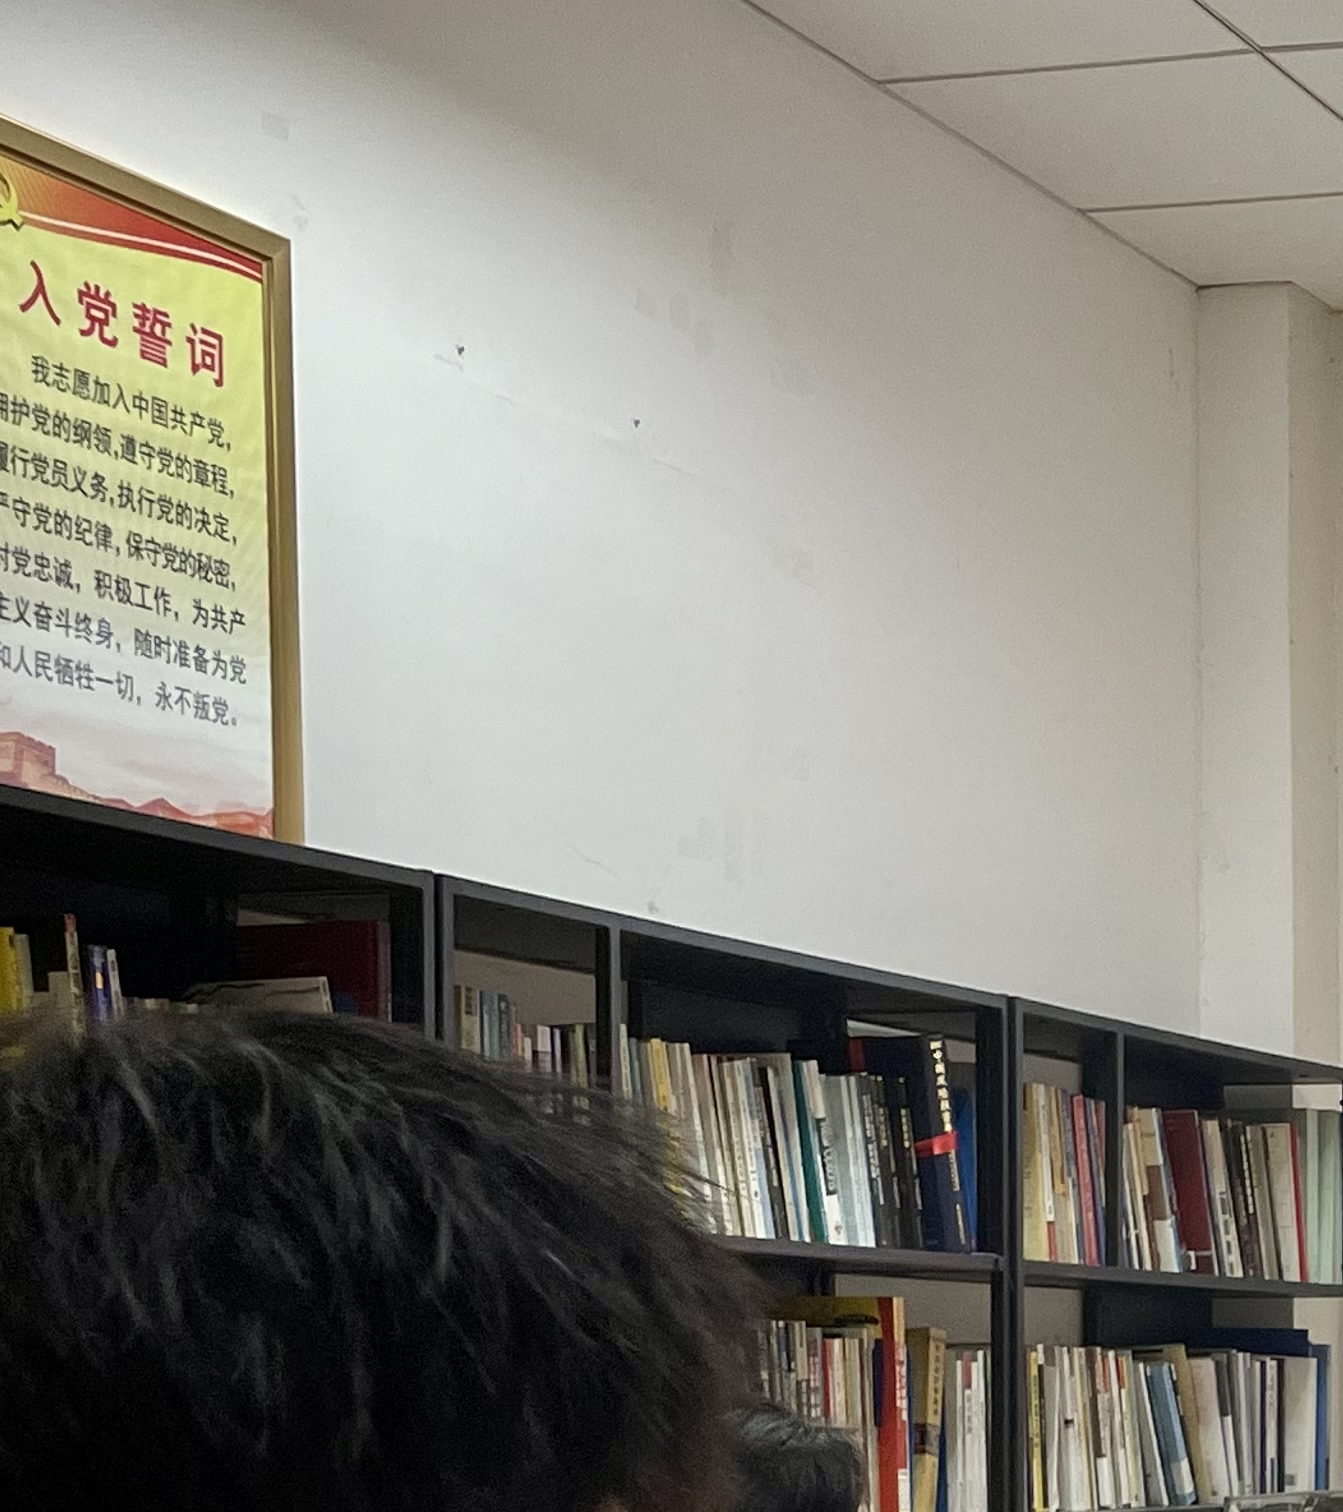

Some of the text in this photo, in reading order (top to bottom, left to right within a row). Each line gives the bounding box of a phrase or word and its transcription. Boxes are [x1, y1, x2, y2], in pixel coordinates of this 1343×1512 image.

[18, 260, 225, 388] 入党誓词
[31, 355, 231, 451] 我志愿加入中国共产党，
